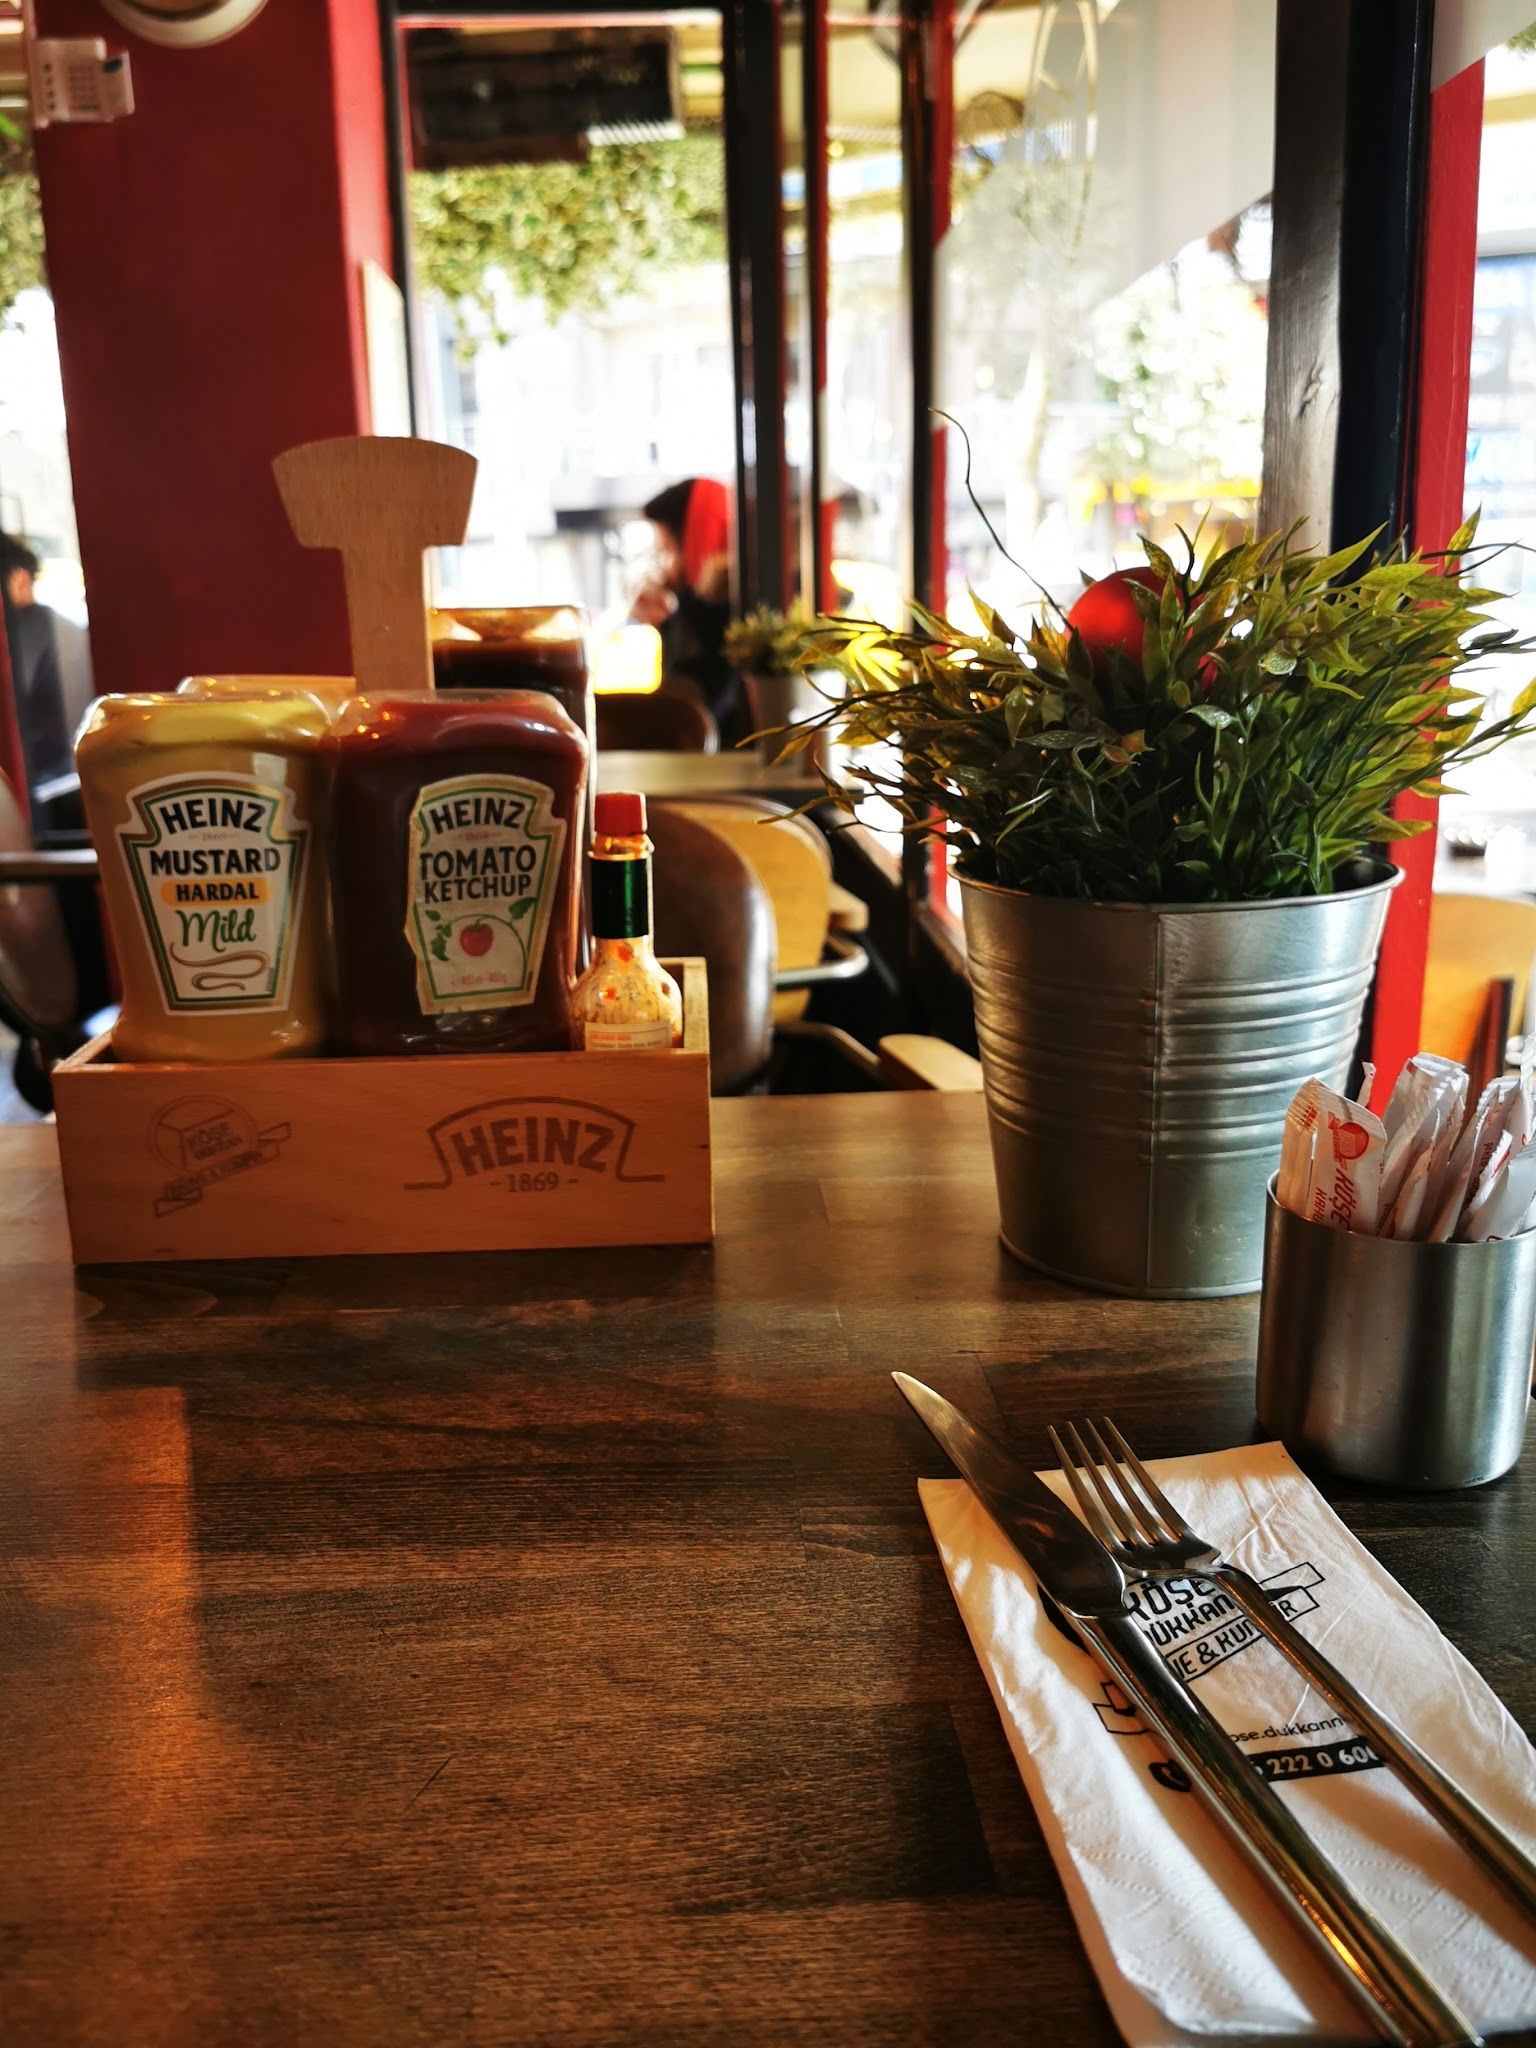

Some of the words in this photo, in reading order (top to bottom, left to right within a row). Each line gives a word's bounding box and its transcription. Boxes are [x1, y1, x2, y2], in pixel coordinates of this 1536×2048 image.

[159, 798, 267, 835] HEINZ
[429, 798, 527, 835] HEINZ
[150, 848, 281, 876] MUSTARD
[420, 845, 537, 881] TOMATO
[176, 882, 260, 902] HARDAL
[424, 874, 532, 904] KETCHUP
[175, 908, 257, 953] Mild
[450, 1115, 616, 1177] HEINZ
[507, 1172, 560, 1193] 1869
[1144, 1594, 1236, 1647] ÜKKAN
[1266, 1754, 1313, 1776] 222
[1317, 1752, 1335, 1769] 0
